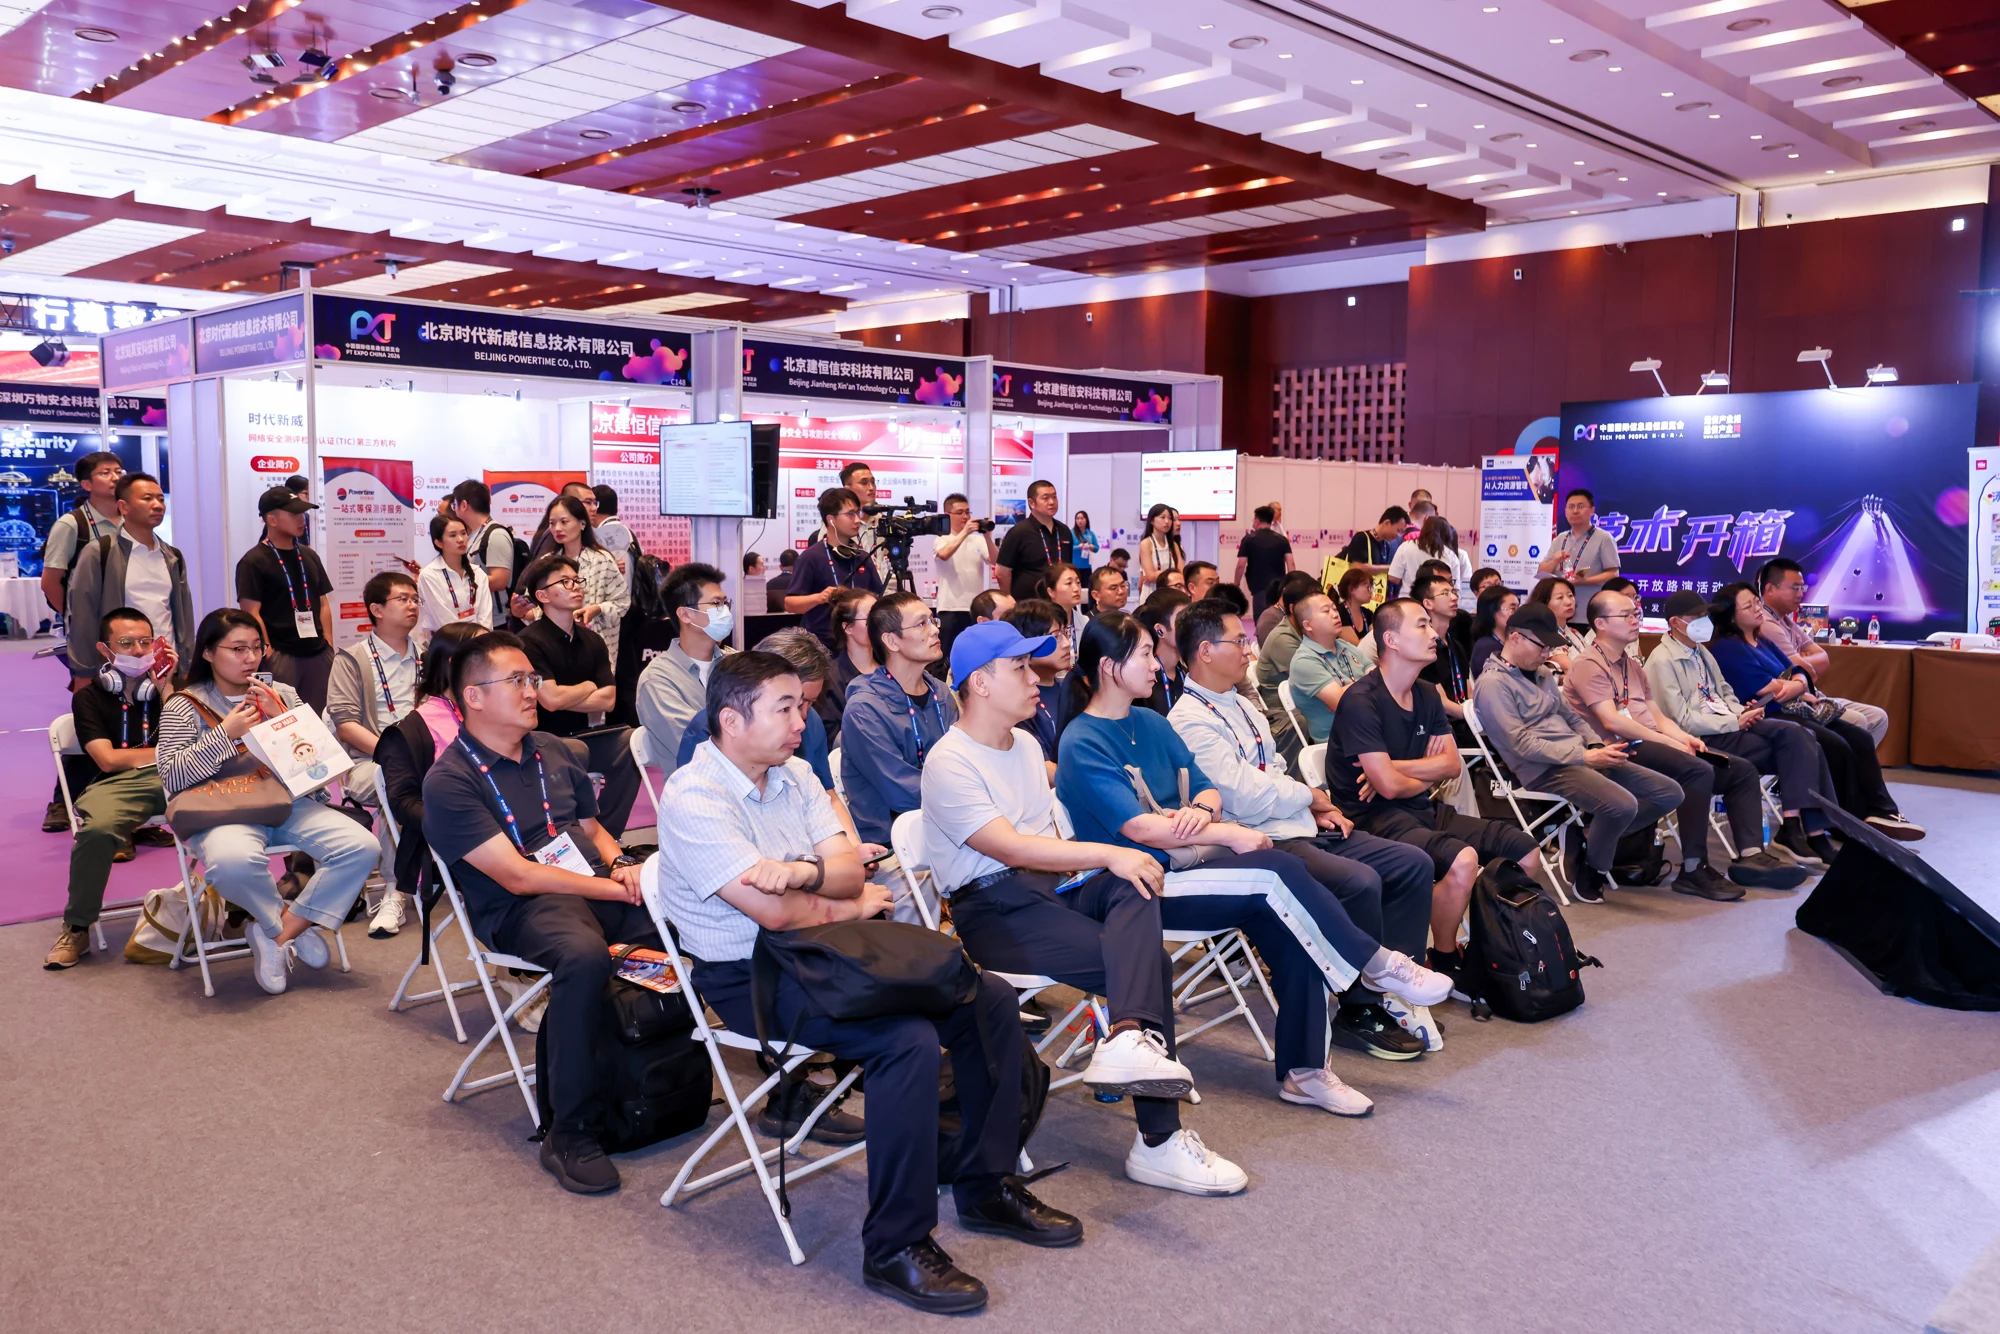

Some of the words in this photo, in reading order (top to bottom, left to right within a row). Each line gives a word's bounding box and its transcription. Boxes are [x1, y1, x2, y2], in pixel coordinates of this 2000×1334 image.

[421, 321, 634, 358] 北京时代新威信息技术有限公司
[474, 350, 508, 363] BEIJING
[508, 353, 556, 367] POWERTIME
[574, 358, 592, 369] LTD.
[783, 356, 914, 382] 北京建恒信安科技有限公司
[788, 378, 810, 389] Beijing
[810, 379, 837, 391] Jianheng
[856, 384, 888, 395] Technology
[1033, 381, 1133, 403] 北京建恒信安科技有限公司
[248, 412, 304, 427] 时代新威
[248, 433, 397, 448] 网络安全测评检认证(TIC)第三方机构
[257, 459, 294, 470] 企业简介
[620, 452, 654, 464] 公司简介
[815, 459, 844, 470] 主营业务
[1484, 481, 1490, 489] AI
[333, 504, 402, 514] 一站式等保测评服务
[272, 720, 283, 731] POP
[282, 715, 296, 727] MART
